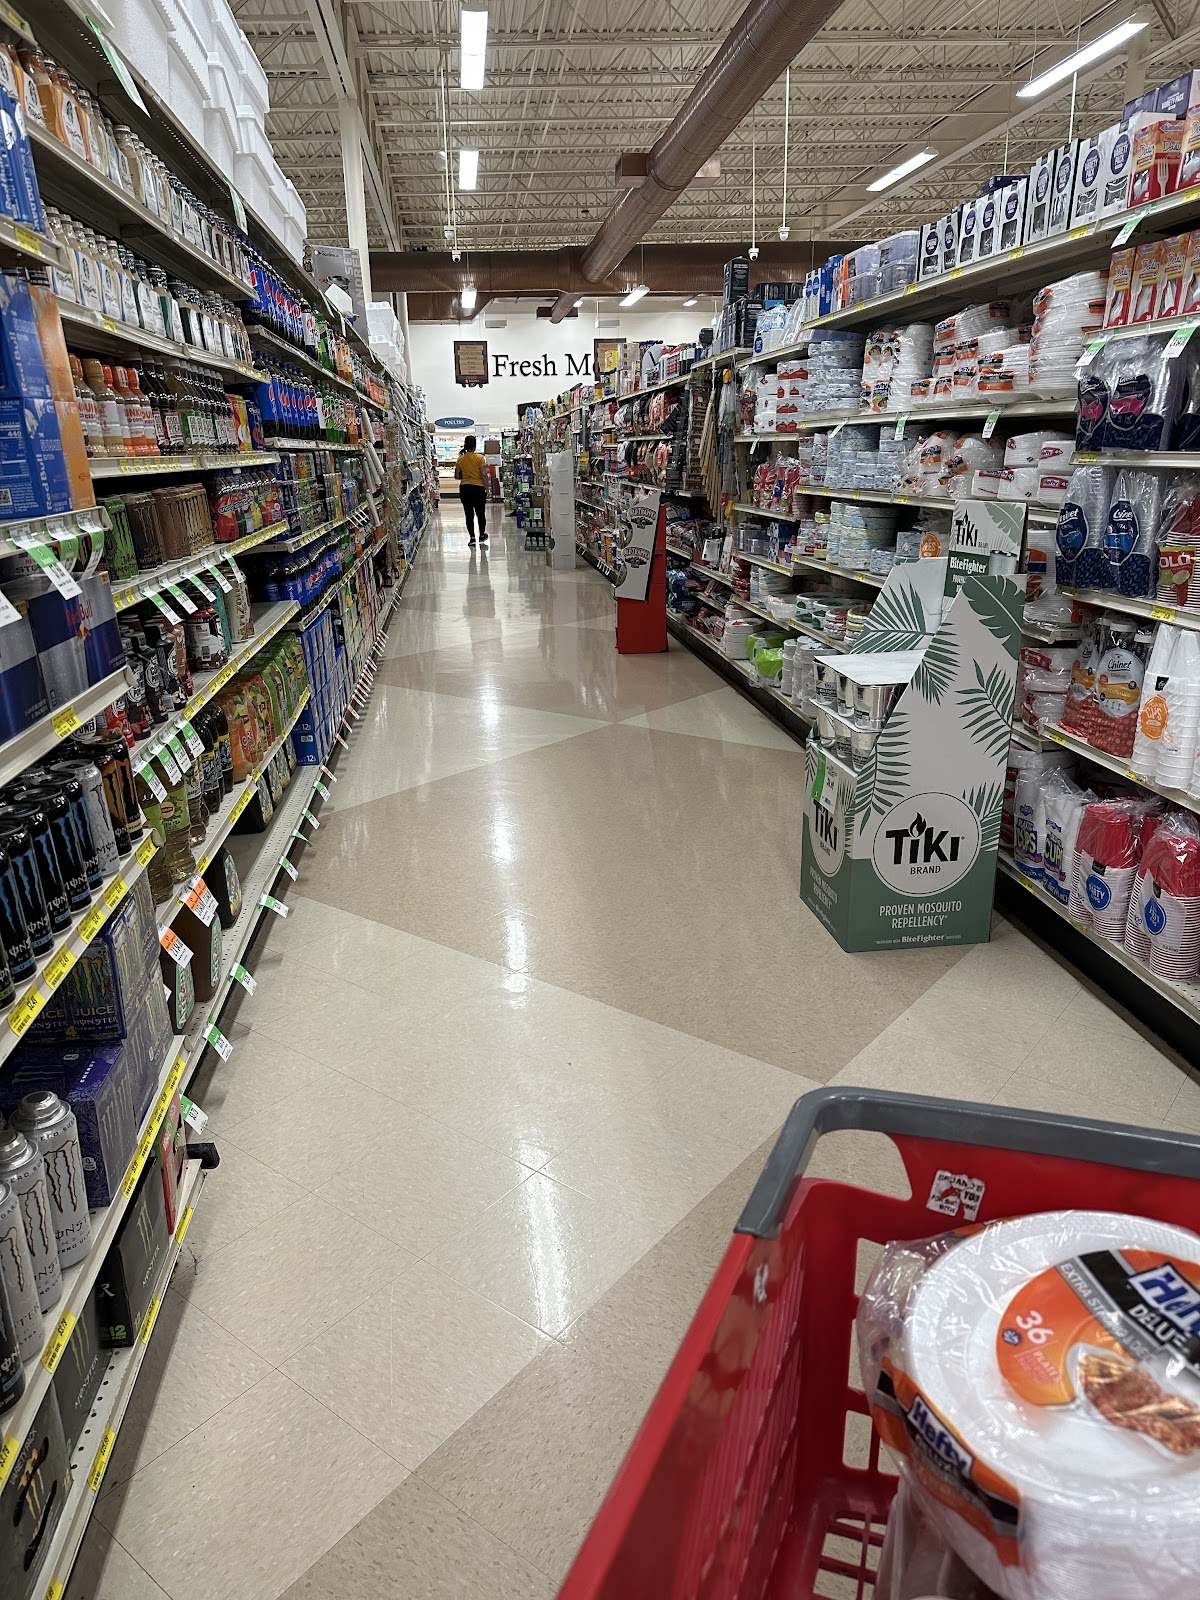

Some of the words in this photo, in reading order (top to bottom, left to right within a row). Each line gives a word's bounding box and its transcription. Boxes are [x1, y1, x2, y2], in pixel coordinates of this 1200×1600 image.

[492, 353, 558, 377] Fresh
[949, 556, 987, 574] BiteFighter
[65, 605, 80, 625] Red
[79, 601, 93, 621] Bull
[1108, 659, 1133, 669] Chinet
[910, 865, 941, 875] BRAND
[879, 903, 914, 916] PROVEN
[917, 900, 962, 914] MOSQUITO
[901, 934, 946, 943] BiteFighter
[26, 995, 38, 1011] $2.49
[73, 1005, 115, 1017] JUICE
[66, 1025, 77, 1036] 4
[80, 1060, 96, 1083] ENERGY
[1060, 1263, 1093, 1299] EXTRA
[1087, 1297, 1127, 1337] STRONG
[109, 1324, 126, 1338] 12
[1015, 1309, 1055, 1345] 36
[1032, 1350, 1063, 1384] PLATES
[911, 1400, 970, 1470] Hefty
[9, 1446, 28, 1486] VARIETY
